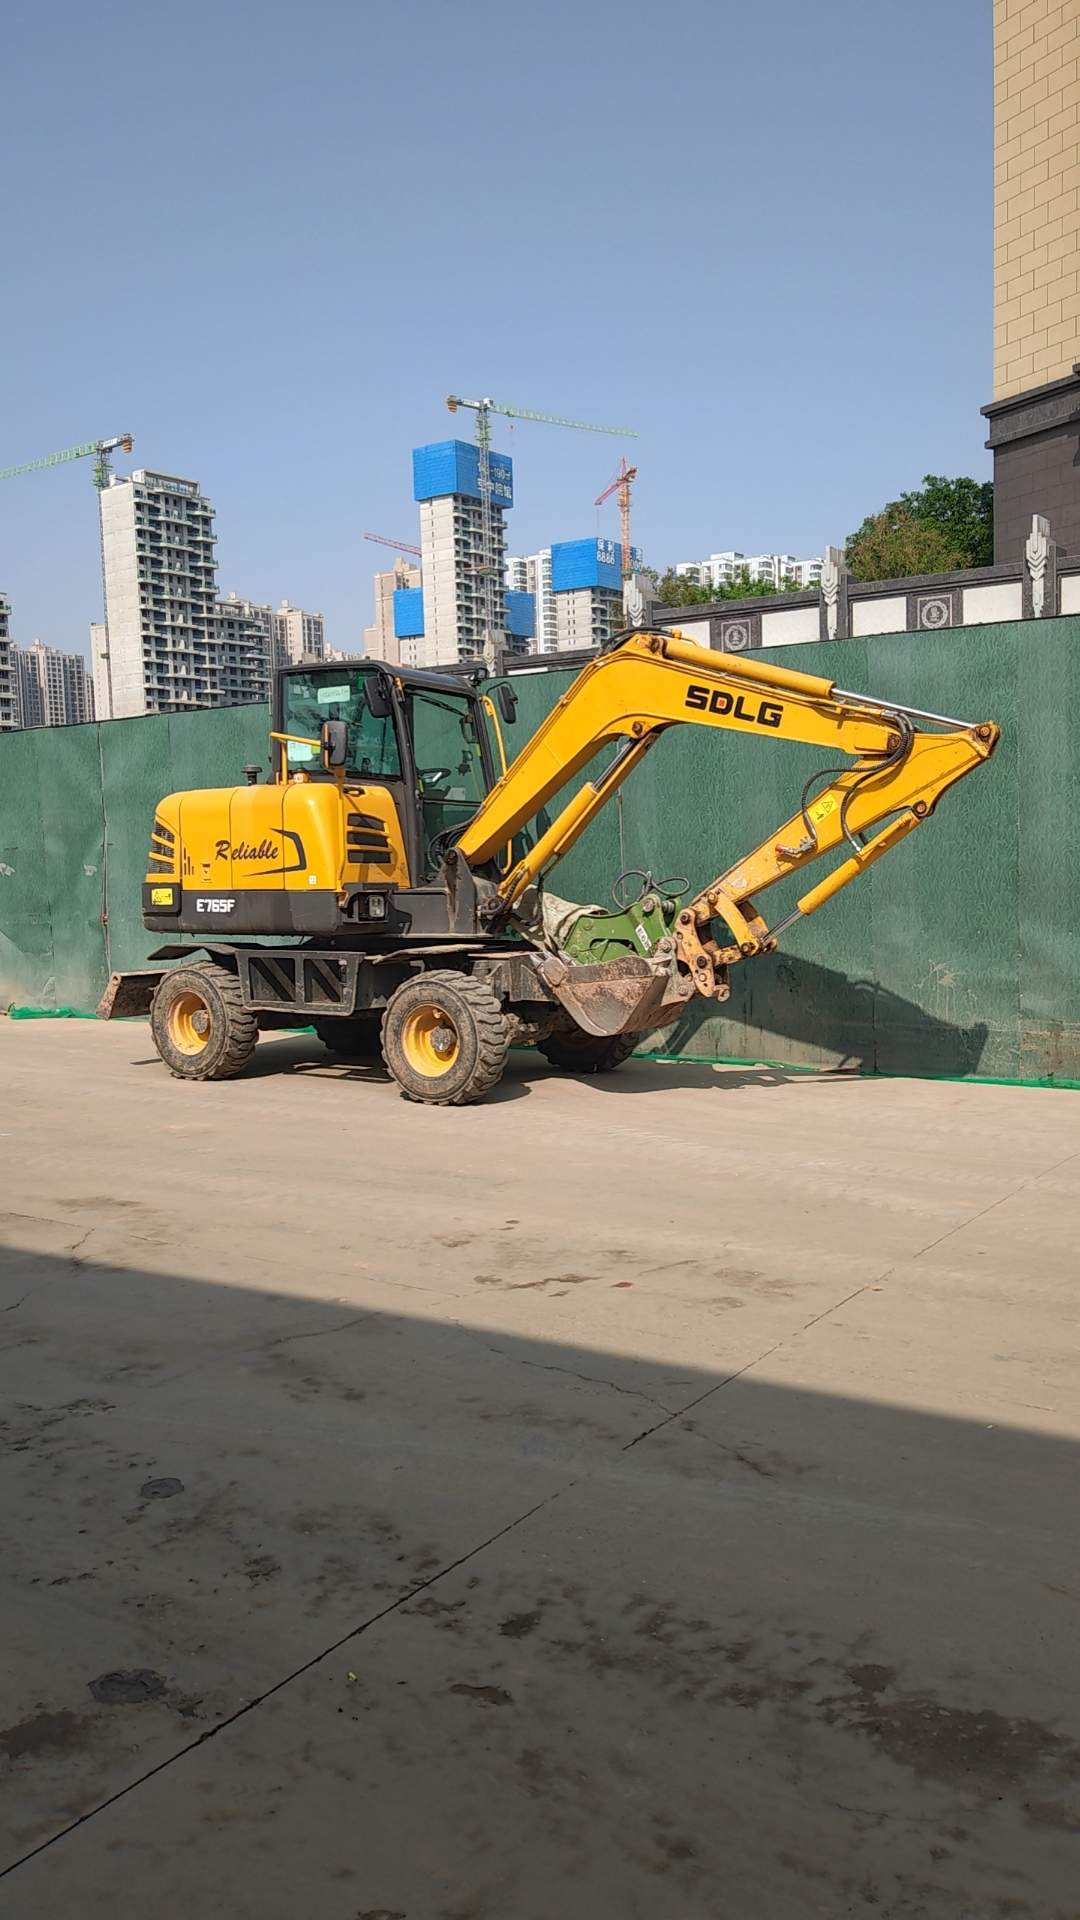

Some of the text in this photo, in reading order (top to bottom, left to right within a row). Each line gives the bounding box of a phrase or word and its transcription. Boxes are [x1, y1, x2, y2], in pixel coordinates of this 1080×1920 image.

[685, 684, 784, 728] SDLG
[215, 839, 279, 860] Reliable
[196, 898, 236, 913] E765F
